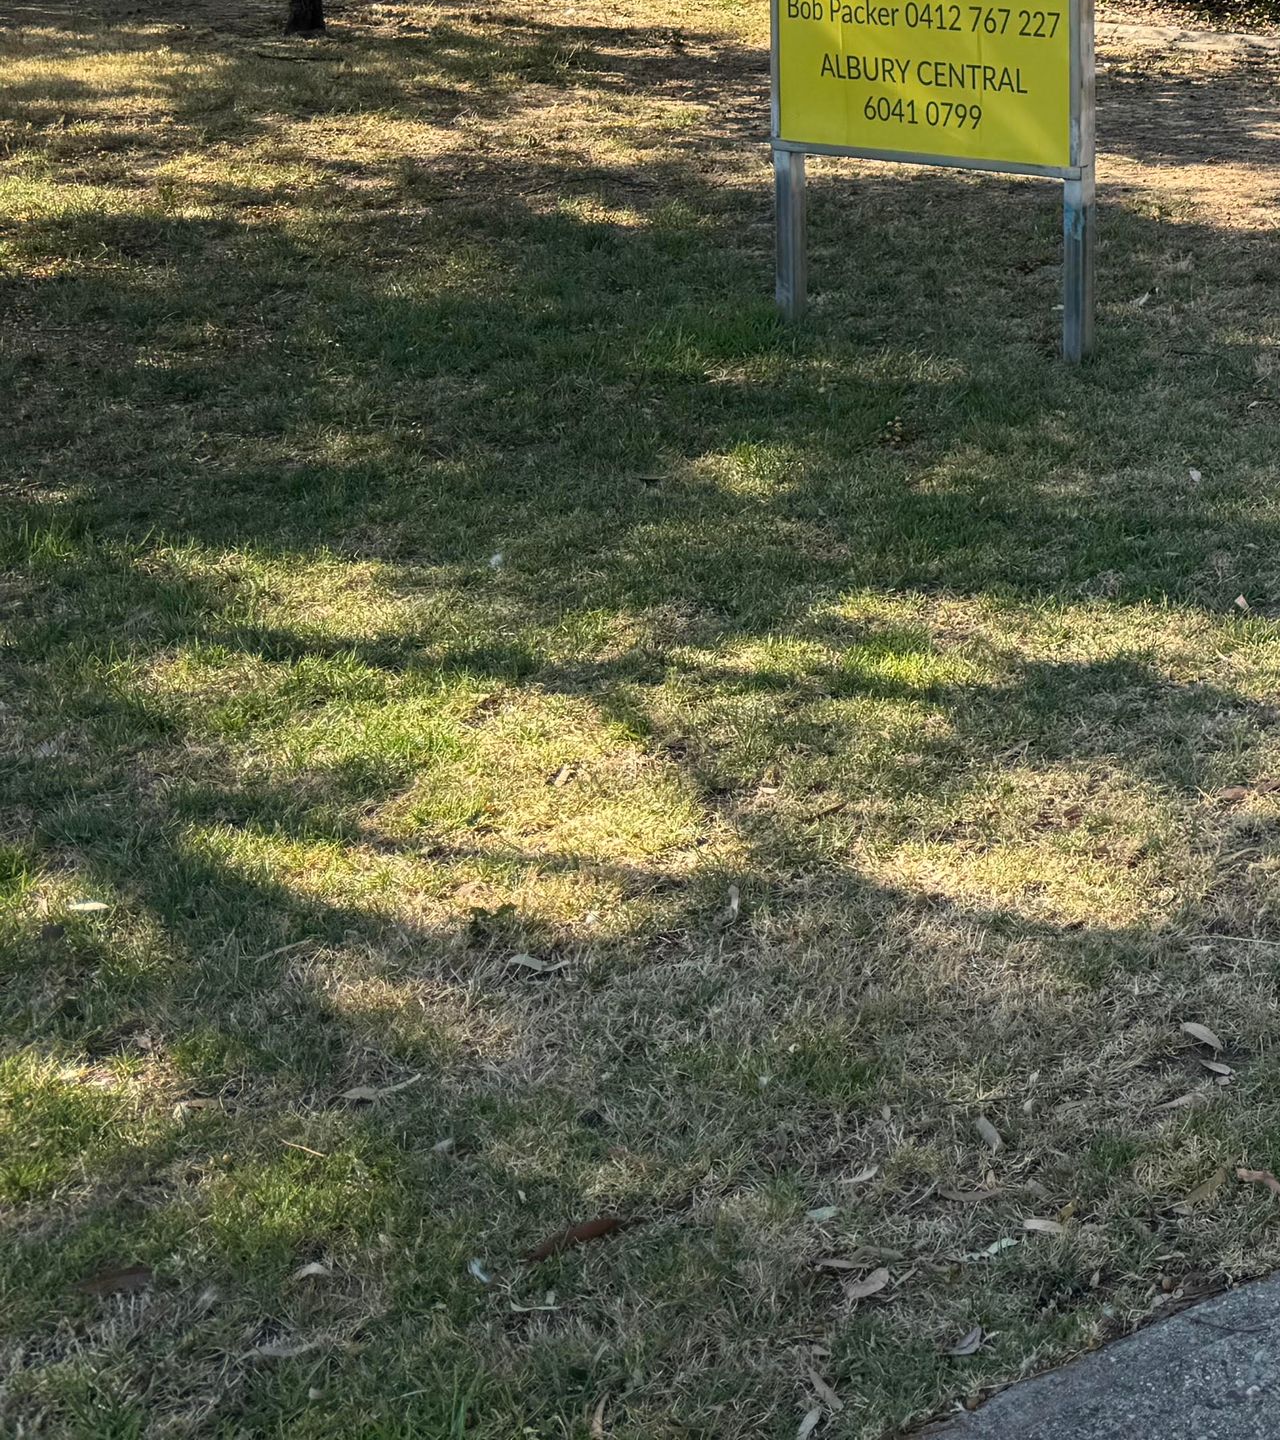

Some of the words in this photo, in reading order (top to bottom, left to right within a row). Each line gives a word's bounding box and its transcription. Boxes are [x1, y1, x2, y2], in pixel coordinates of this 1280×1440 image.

[905, 1, 962, 32] 0412
[968, 6, 1011, 35] 767
[1018, 9, 1061, 39] 227
[820, 53, 911, 84] ALBURY
[916, 60, 1028, 94] CENTRAL
[863, 95, 919, 125] 6041
[925, 101, 982, 130] 0799
